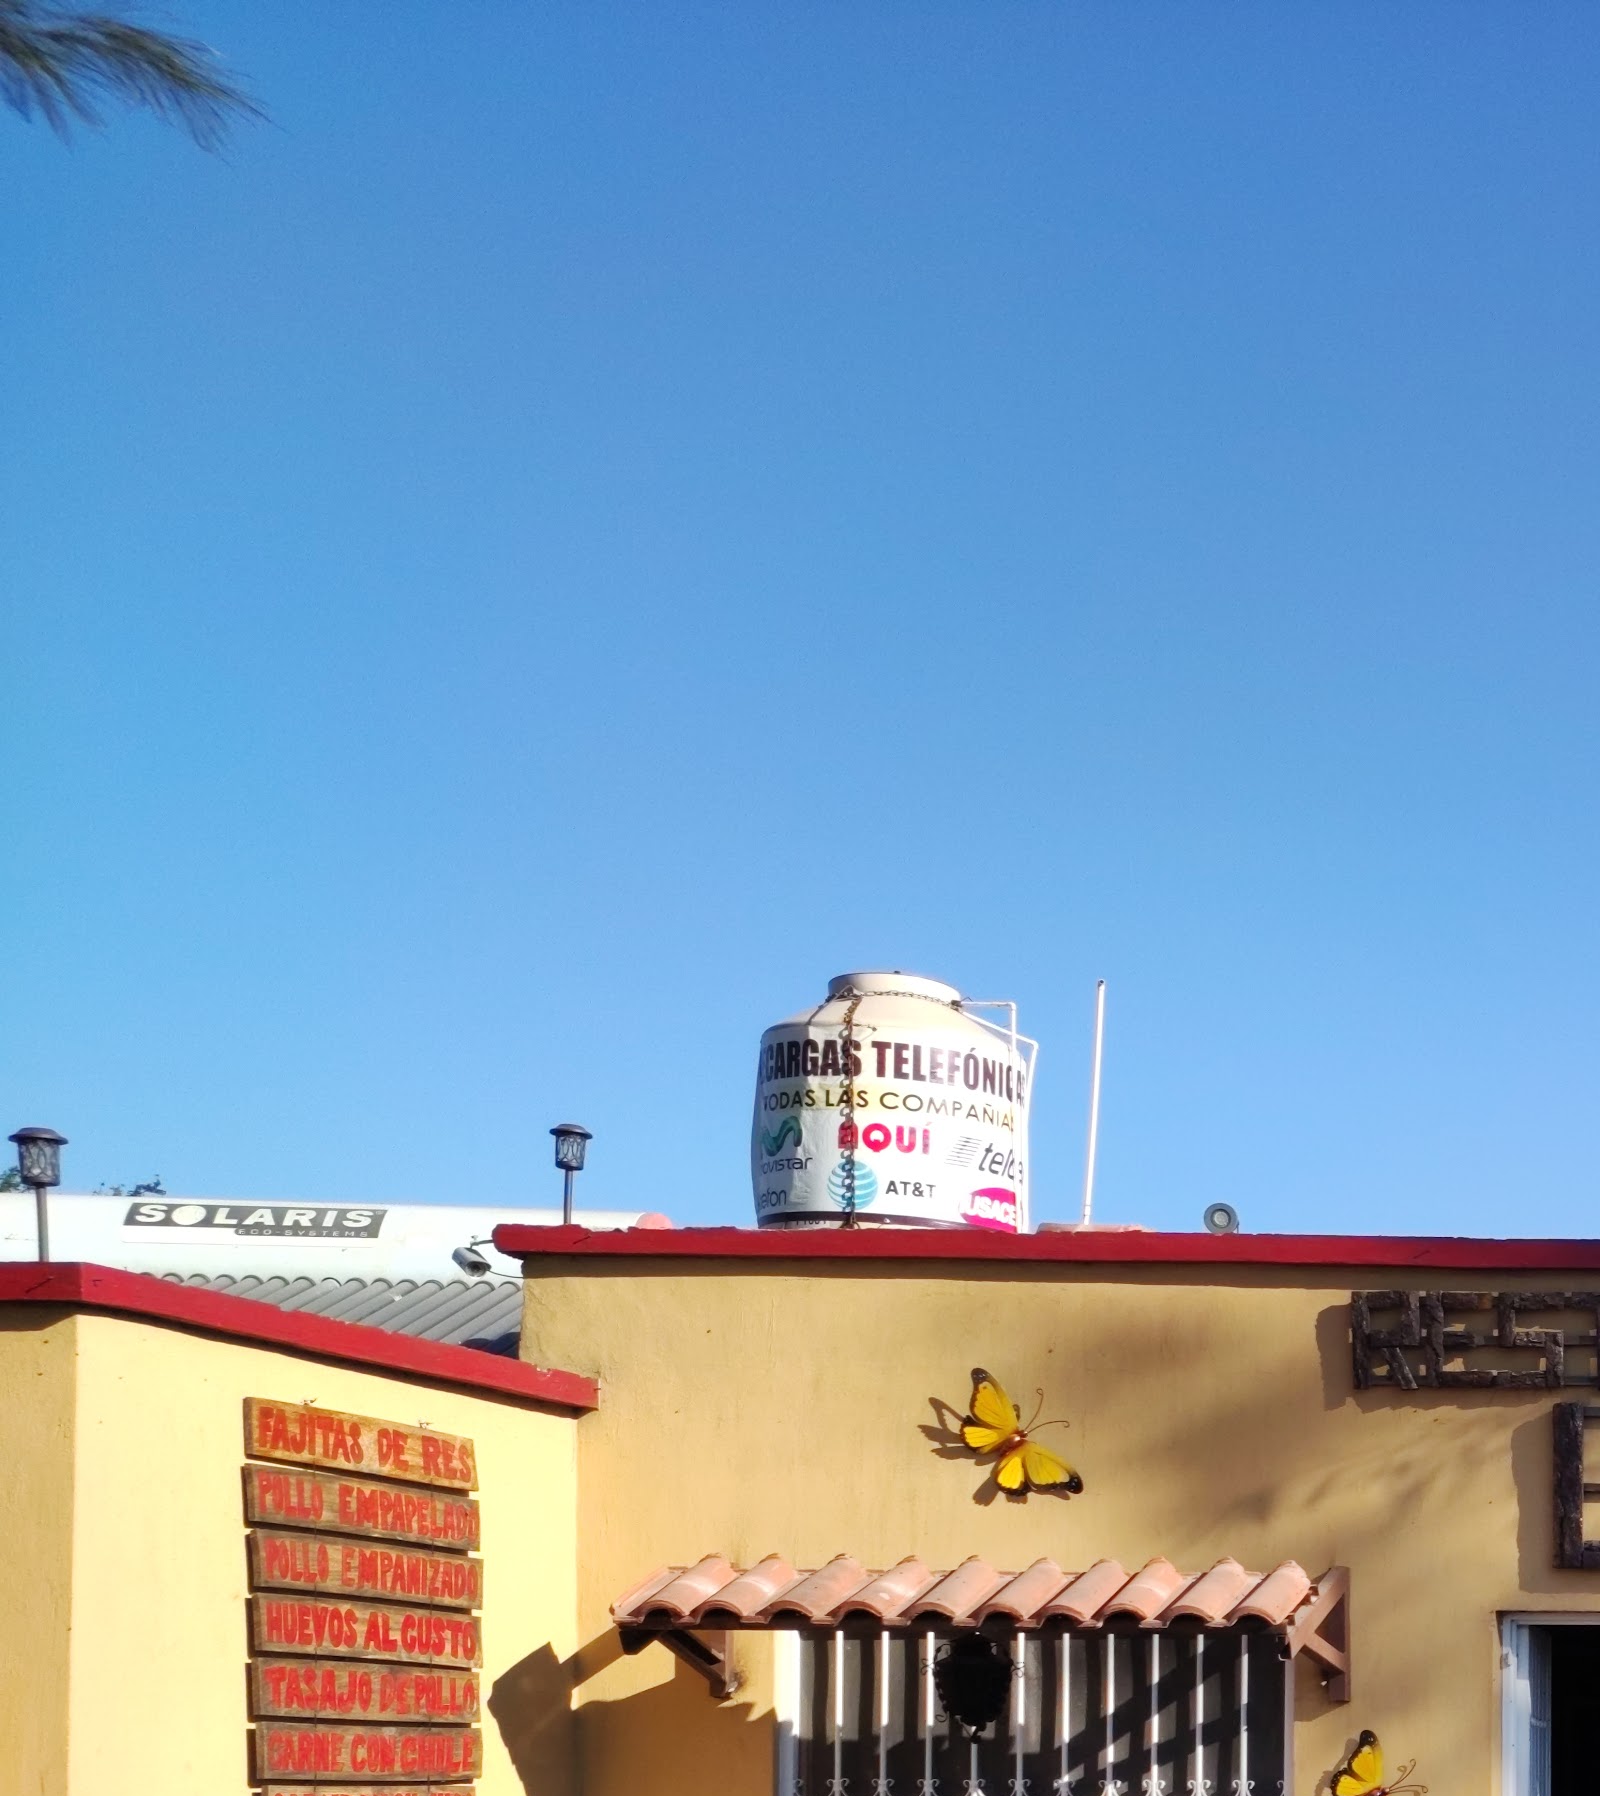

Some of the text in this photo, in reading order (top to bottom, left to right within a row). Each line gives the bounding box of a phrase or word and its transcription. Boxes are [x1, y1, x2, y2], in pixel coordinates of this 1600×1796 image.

[760, 1039, 862, 1082] CARGAS
[825, 1090, 869, 1109] LAS
[880, 1092, 1014, 1131] COMPAÑIA
[838, 1120, 931, 1155] AQUÍ
[762, 1157, 813, 1175] ovistar
[885, 1180, 936, 1198] AT&T
[134, 1204, 375, 1228] SOLARIS
[258, 1406, 472, 1483] FAJITAS DE RES
[257, 1471, 480, 1541] POLLO EMPAPELADO
[264, 1537, 479, 1600] POLLO EMPANIZADO
[266, 1602, 477, 1660] HUEVOS AL GUSTO
[264, 1665, 478, 1715] TASAJO DE POLLO
[268, 1730, 475, 1773] CARNE CON CHILE
